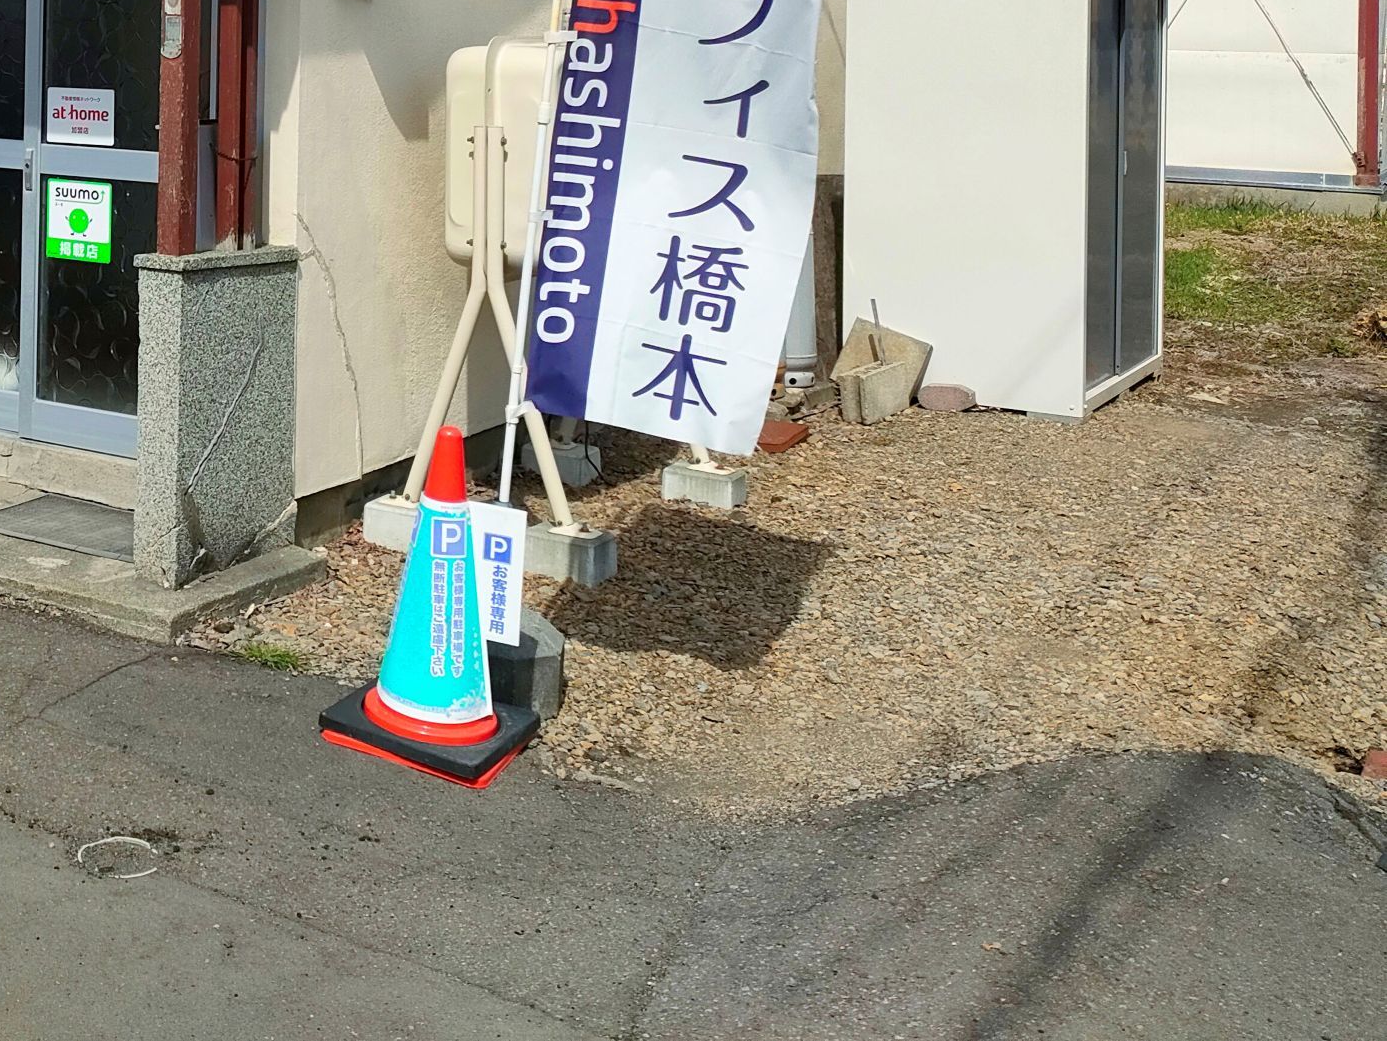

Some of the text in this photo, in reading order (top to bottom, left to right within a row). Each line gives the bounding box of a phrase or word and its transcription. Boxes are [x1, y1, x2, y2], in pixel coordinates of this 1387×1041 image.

[53, 104, 109, 121] at home
[536, 0, 637, 344] hashimoto
[59, 241, 99, 259] 掲載店
[441, 522, 461, 553] P
[490, 538, 508, 559] P
[489, 564, 508, 635] お客様専用
